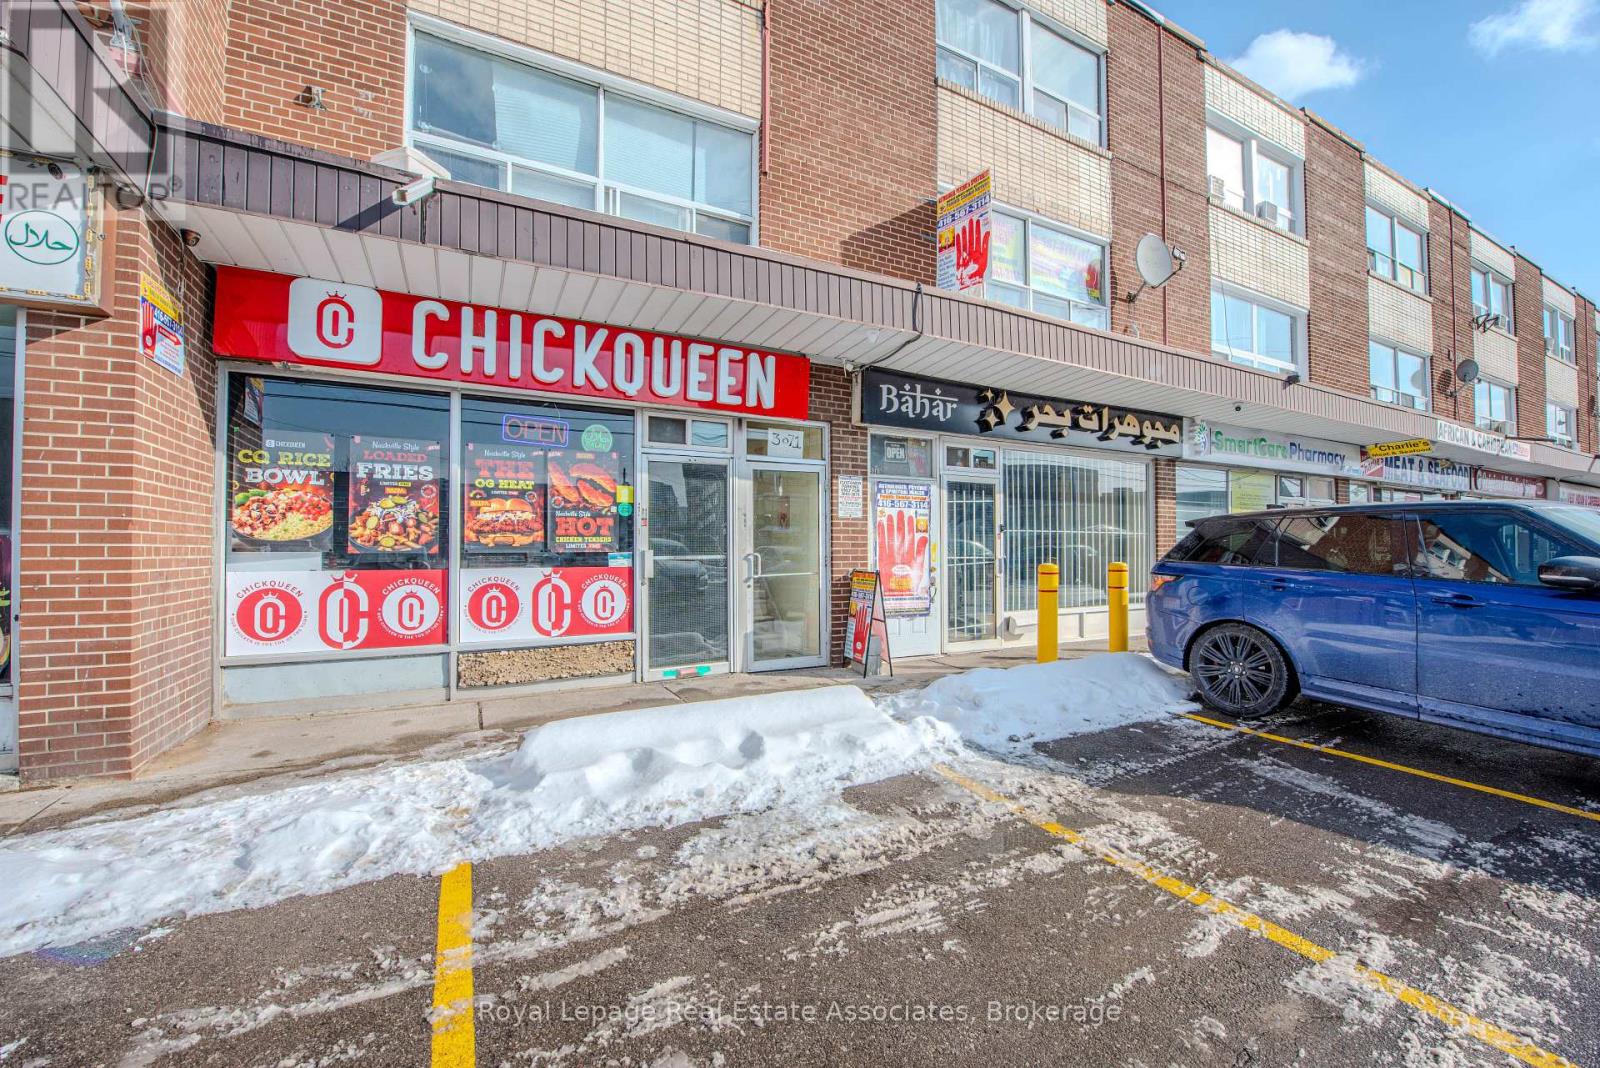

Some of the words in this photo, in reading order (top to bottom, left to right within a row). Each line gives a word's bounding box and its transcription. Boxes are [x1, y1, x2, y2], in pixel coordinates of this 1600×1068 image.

[9, 222, 73, 251] حلال
[411, 300, 776, 410] CHICKQUEEN
[880, 383, 959, 421] Bahar
[505, 417, 566, 444] OPEN
[1438, 422, 1470, 446] AFRICAN
[886, 447, 905, 459] OPEN
[1379, 440, 1430, 452] Charlie's
[278, 451, 331, 467] RICE
[363, 450, 428, 463] LOADED
[245, 467, 325, 486] BOWL
[356, 462, 434, 481] FRIES
[475, 459, 535, 479] THE
[1384, 455, 1415, 482] MEAT
[498, 479, 535, 490] HEAT
[878, 500, 928, 509] 416-567-3114
[555, 517, 614, 536] HOT
[236, 580, 304, 599] CHICKQUEEN
[382, 577, 440, 595] CHICKQUEEN
[467, 576, 520, 593] CHICKQUEEN
[581, 573, 628, 590] CHICKQUEEN
